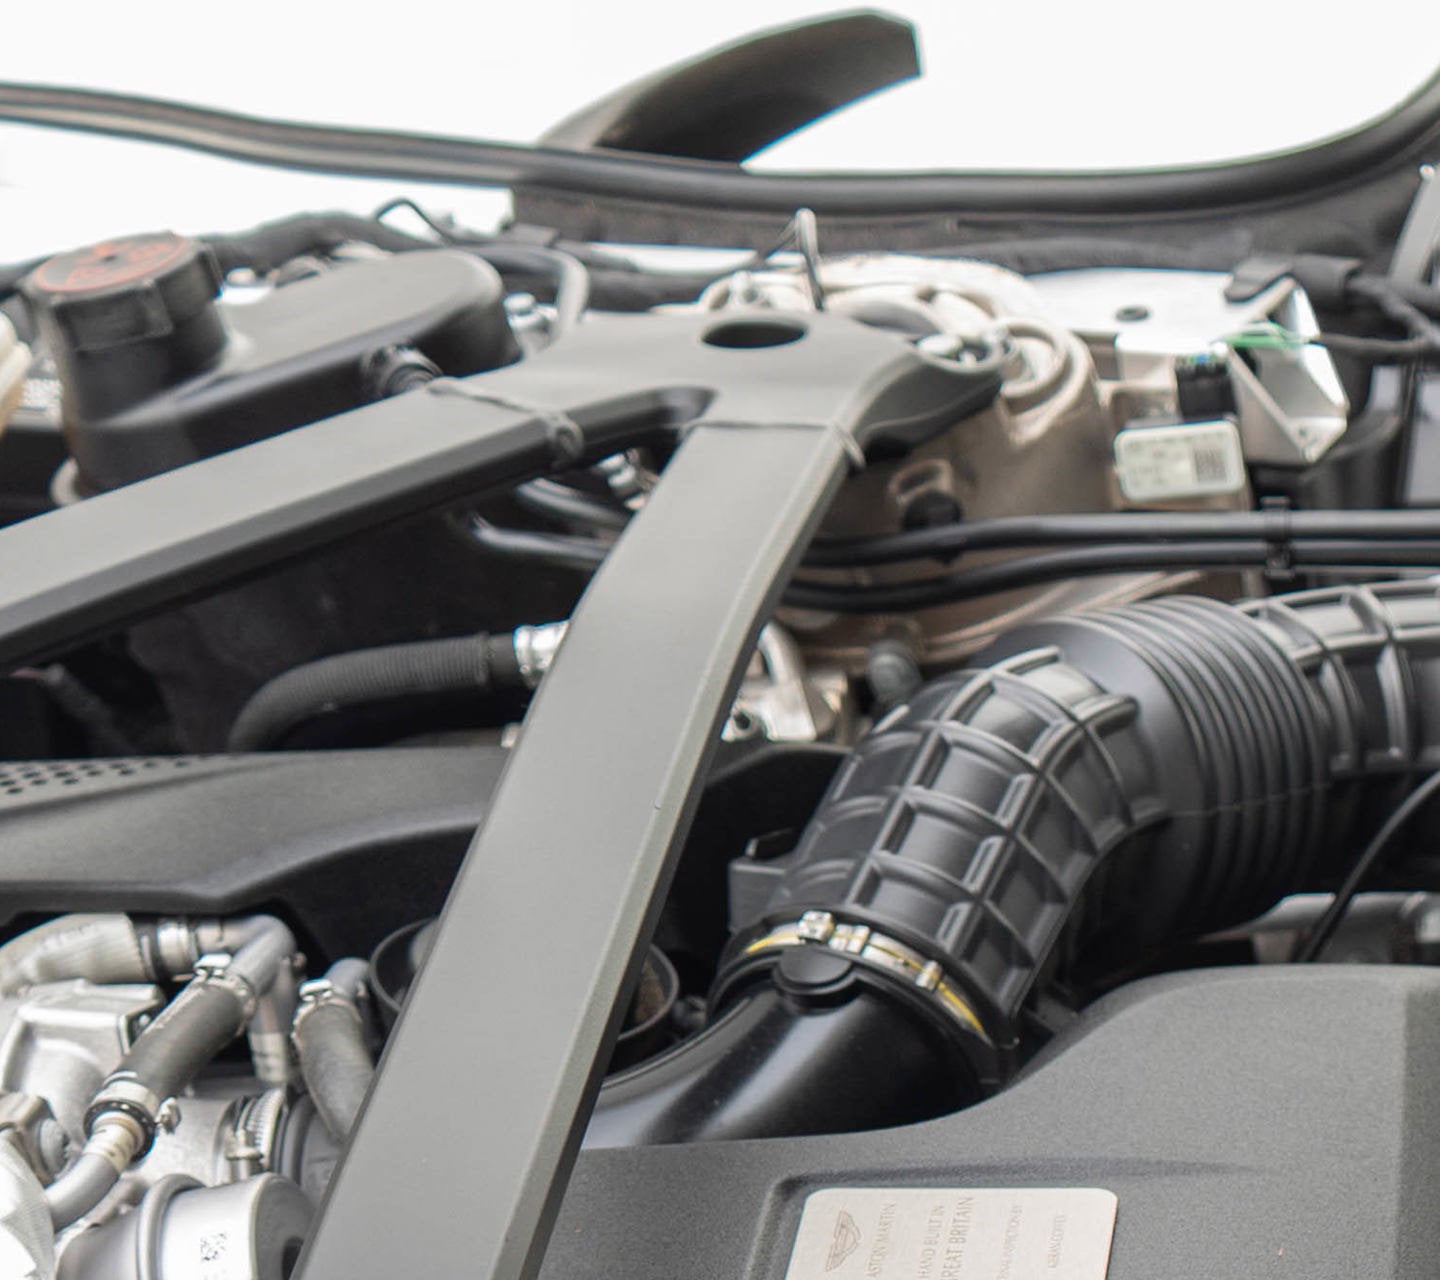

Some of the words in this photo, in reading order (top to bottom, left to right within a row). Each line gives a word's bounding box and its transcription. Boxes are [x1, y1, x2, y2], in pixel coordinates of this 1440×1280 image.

[874, 1201, 897, 1243] MARTIN
[922, 1217, 942, 1246] BUILT
[945, 1196, 974, 1245] BRITAIN
[865, 1246, 888, 1278] ASTON
[916, 1248, 936, 1280] HAND
